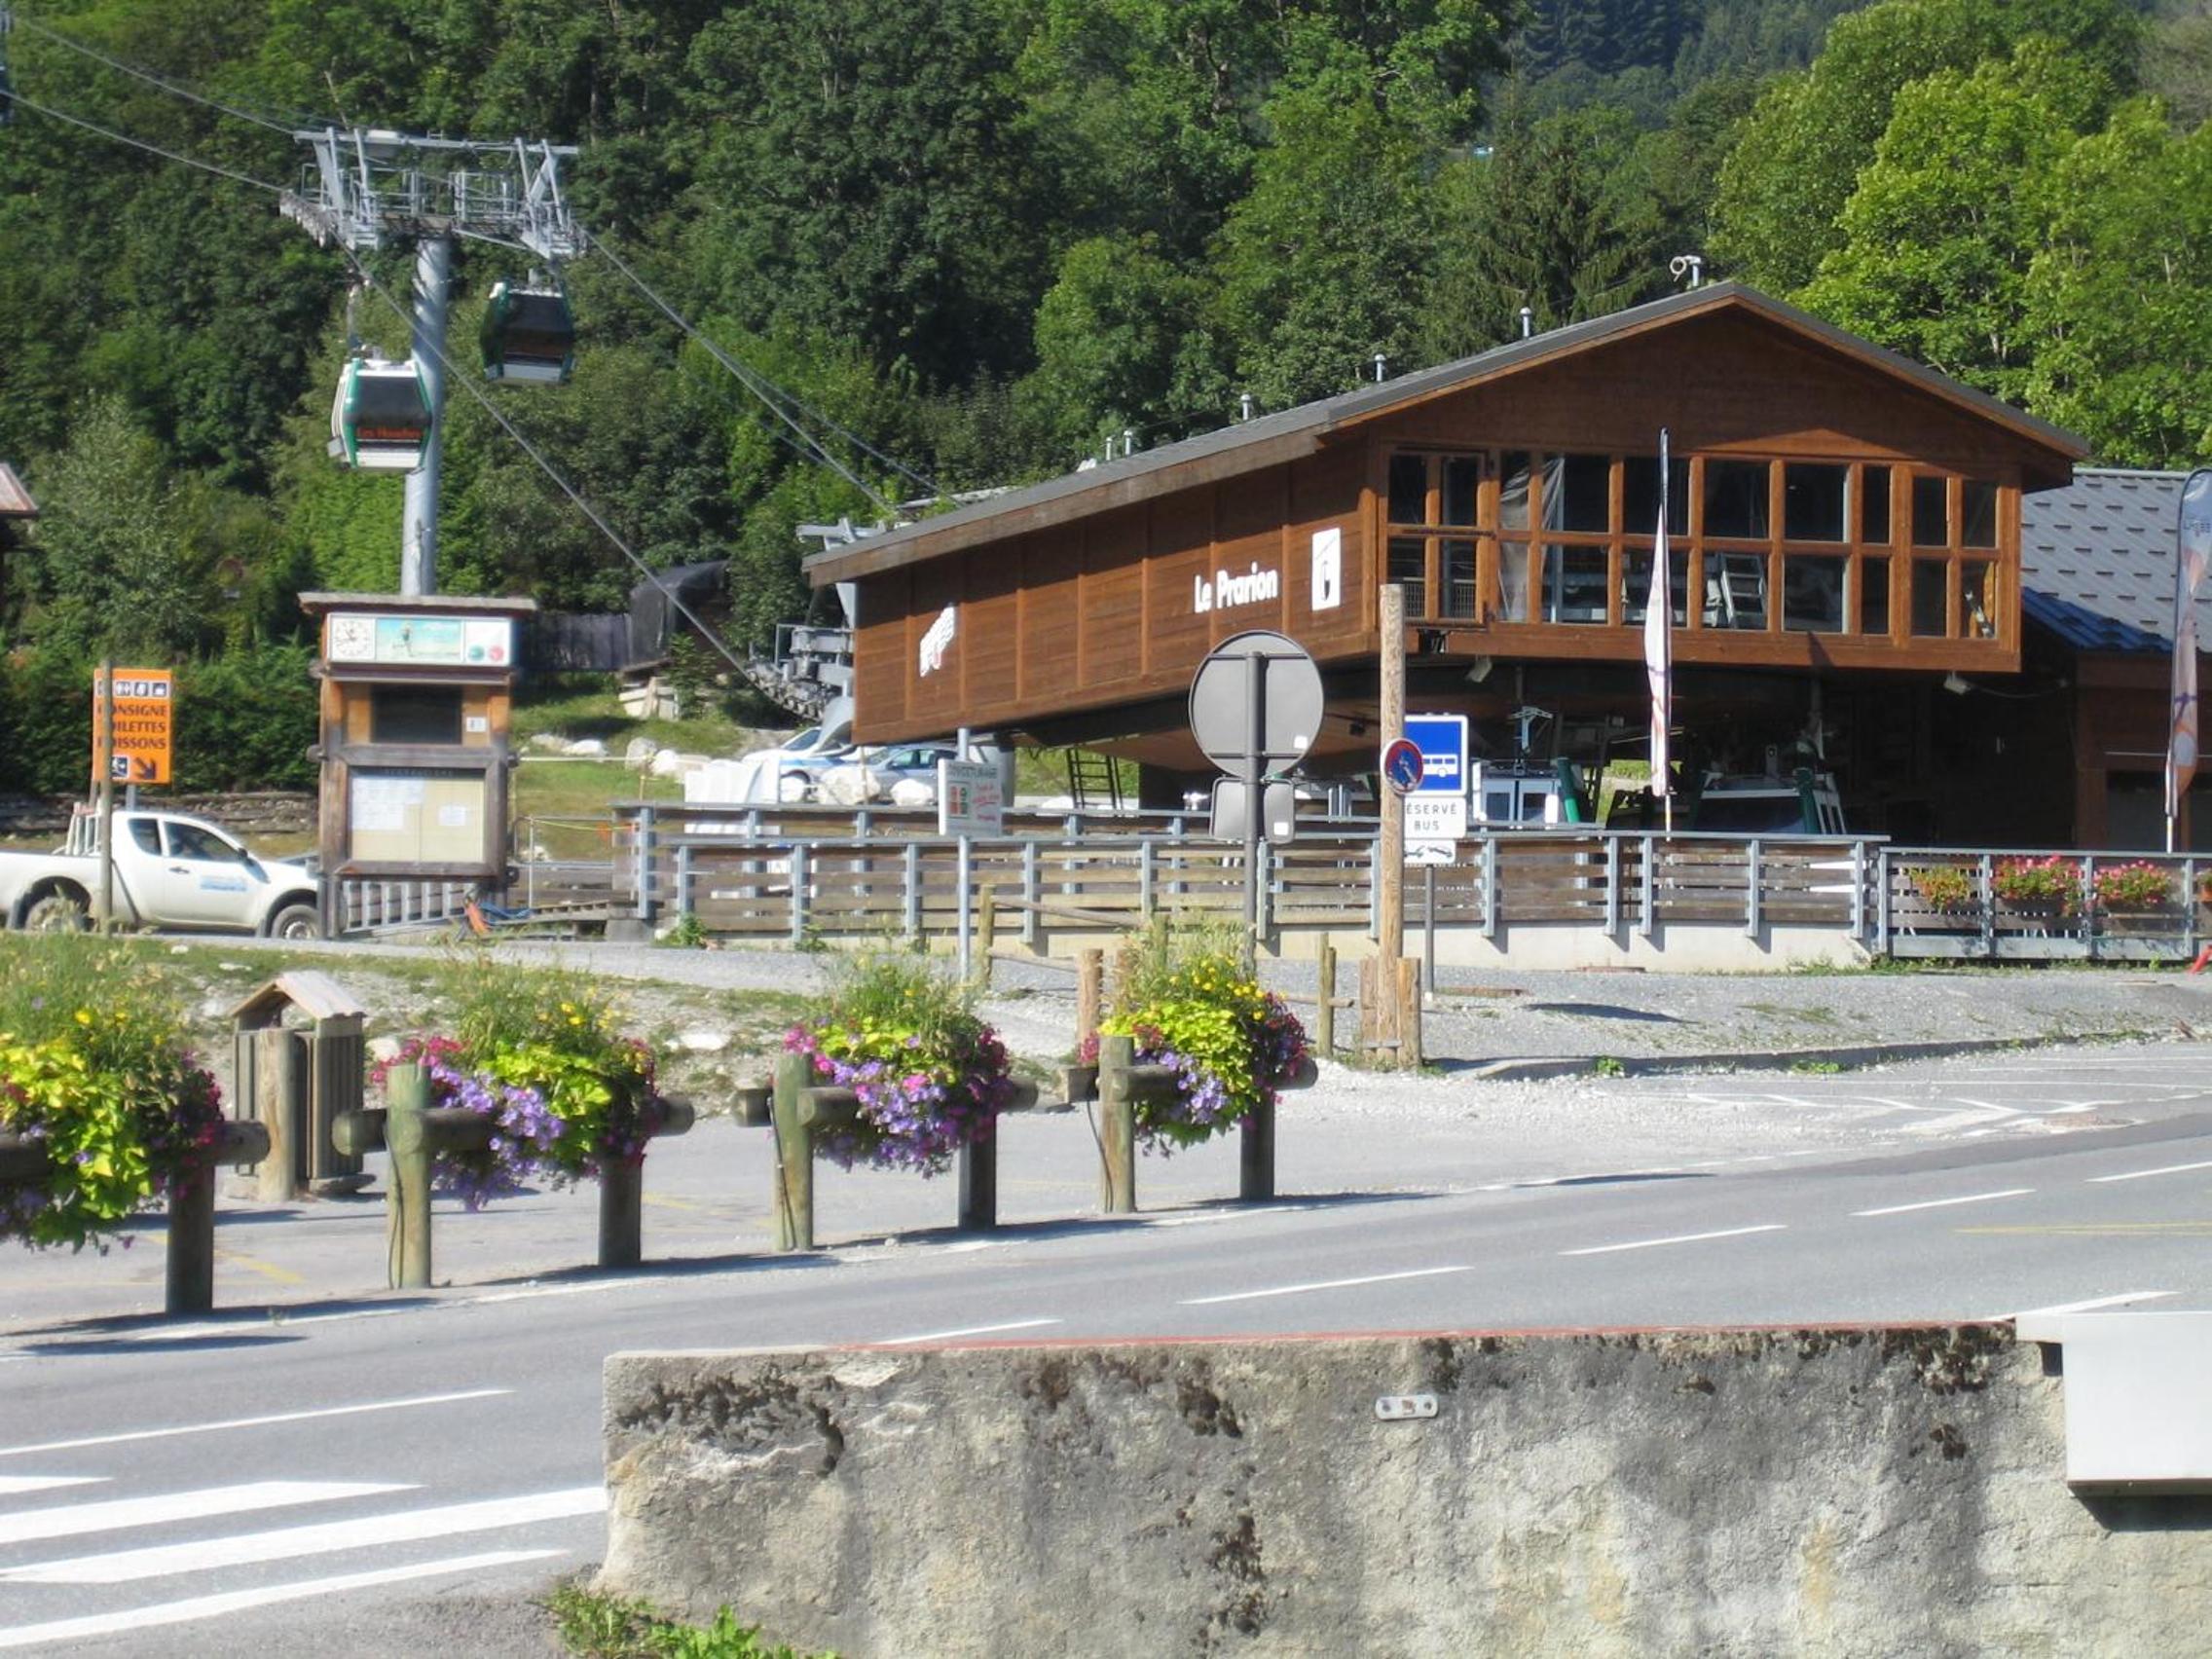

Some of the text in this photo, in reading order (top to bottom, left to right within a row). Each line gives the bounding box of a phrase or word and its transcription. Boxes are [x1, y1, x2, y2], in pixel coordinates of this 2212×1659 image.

[1195, 561, 1278, 613] Le Prarion
[98, 720, 166, 733] OILETTES
[1402, 803, 1457, 815] ÉSERVÉ
[1414, 820, 1440, 831] BUS
